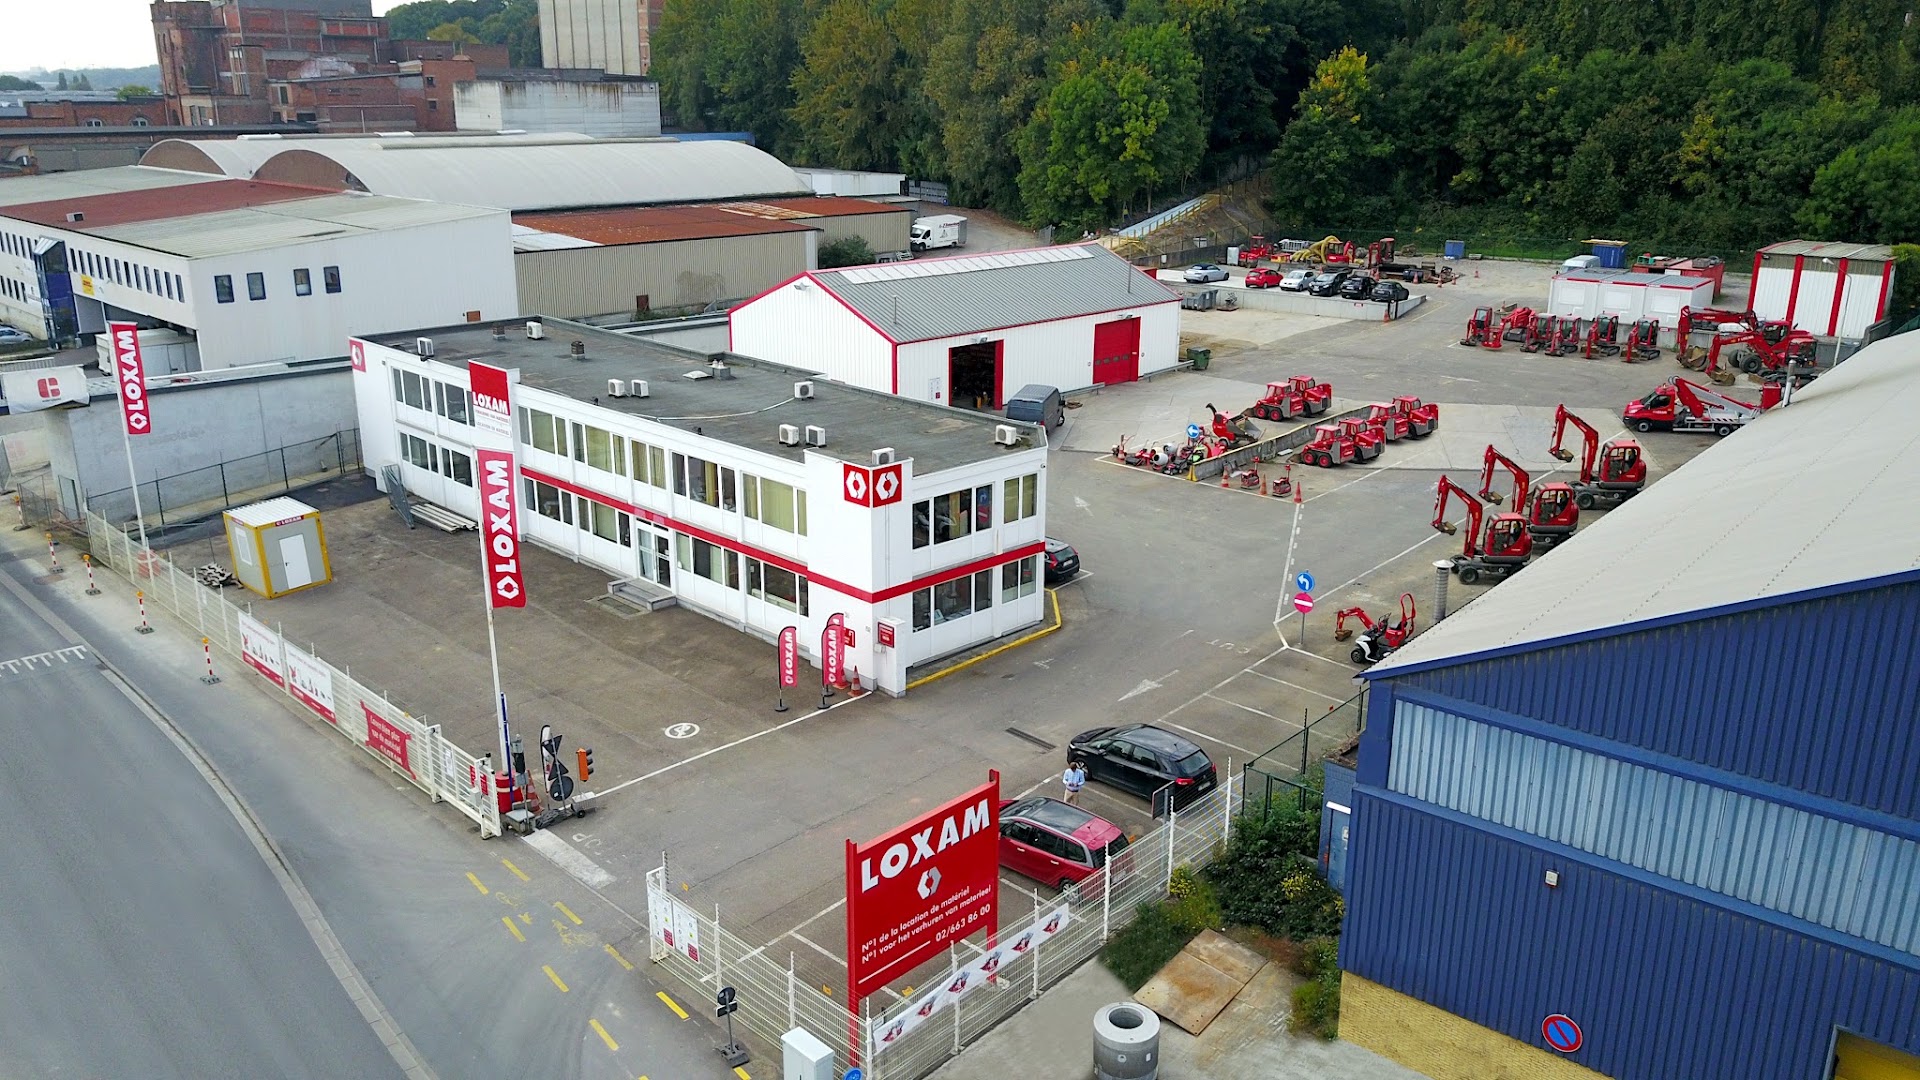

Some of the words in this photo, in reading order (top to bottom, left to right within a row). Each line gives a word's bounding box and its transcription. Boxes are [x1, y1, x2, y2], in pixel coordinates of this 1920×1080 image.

[117, 330, 144, 411] LOXAM
[472, 391, 509, 415] LOXAM
[485, 460, 517, 574] LOXAM
[785, 631, 794, 676] LOXAM
[828, 629, 837, 674] LOXAM
[861, 798, 990, 893] LOXAM
[879, 933, 890, 943] de
[891, 928, 899, 937] la
[900, 910, 929, 931] location
[930, 905, 940, 914] de
[941, 885, 970, 909] matériel
[879, 941, 897, 954] voor
[898, 932, 911, 944] het
[911, 913, 944, 935] verhuren
[945, 905, 958, 917] van
[935, 918, 966, 942] 02/663
[967, 911, 978, 924] 86
[980, 904, 991, 916] 00
